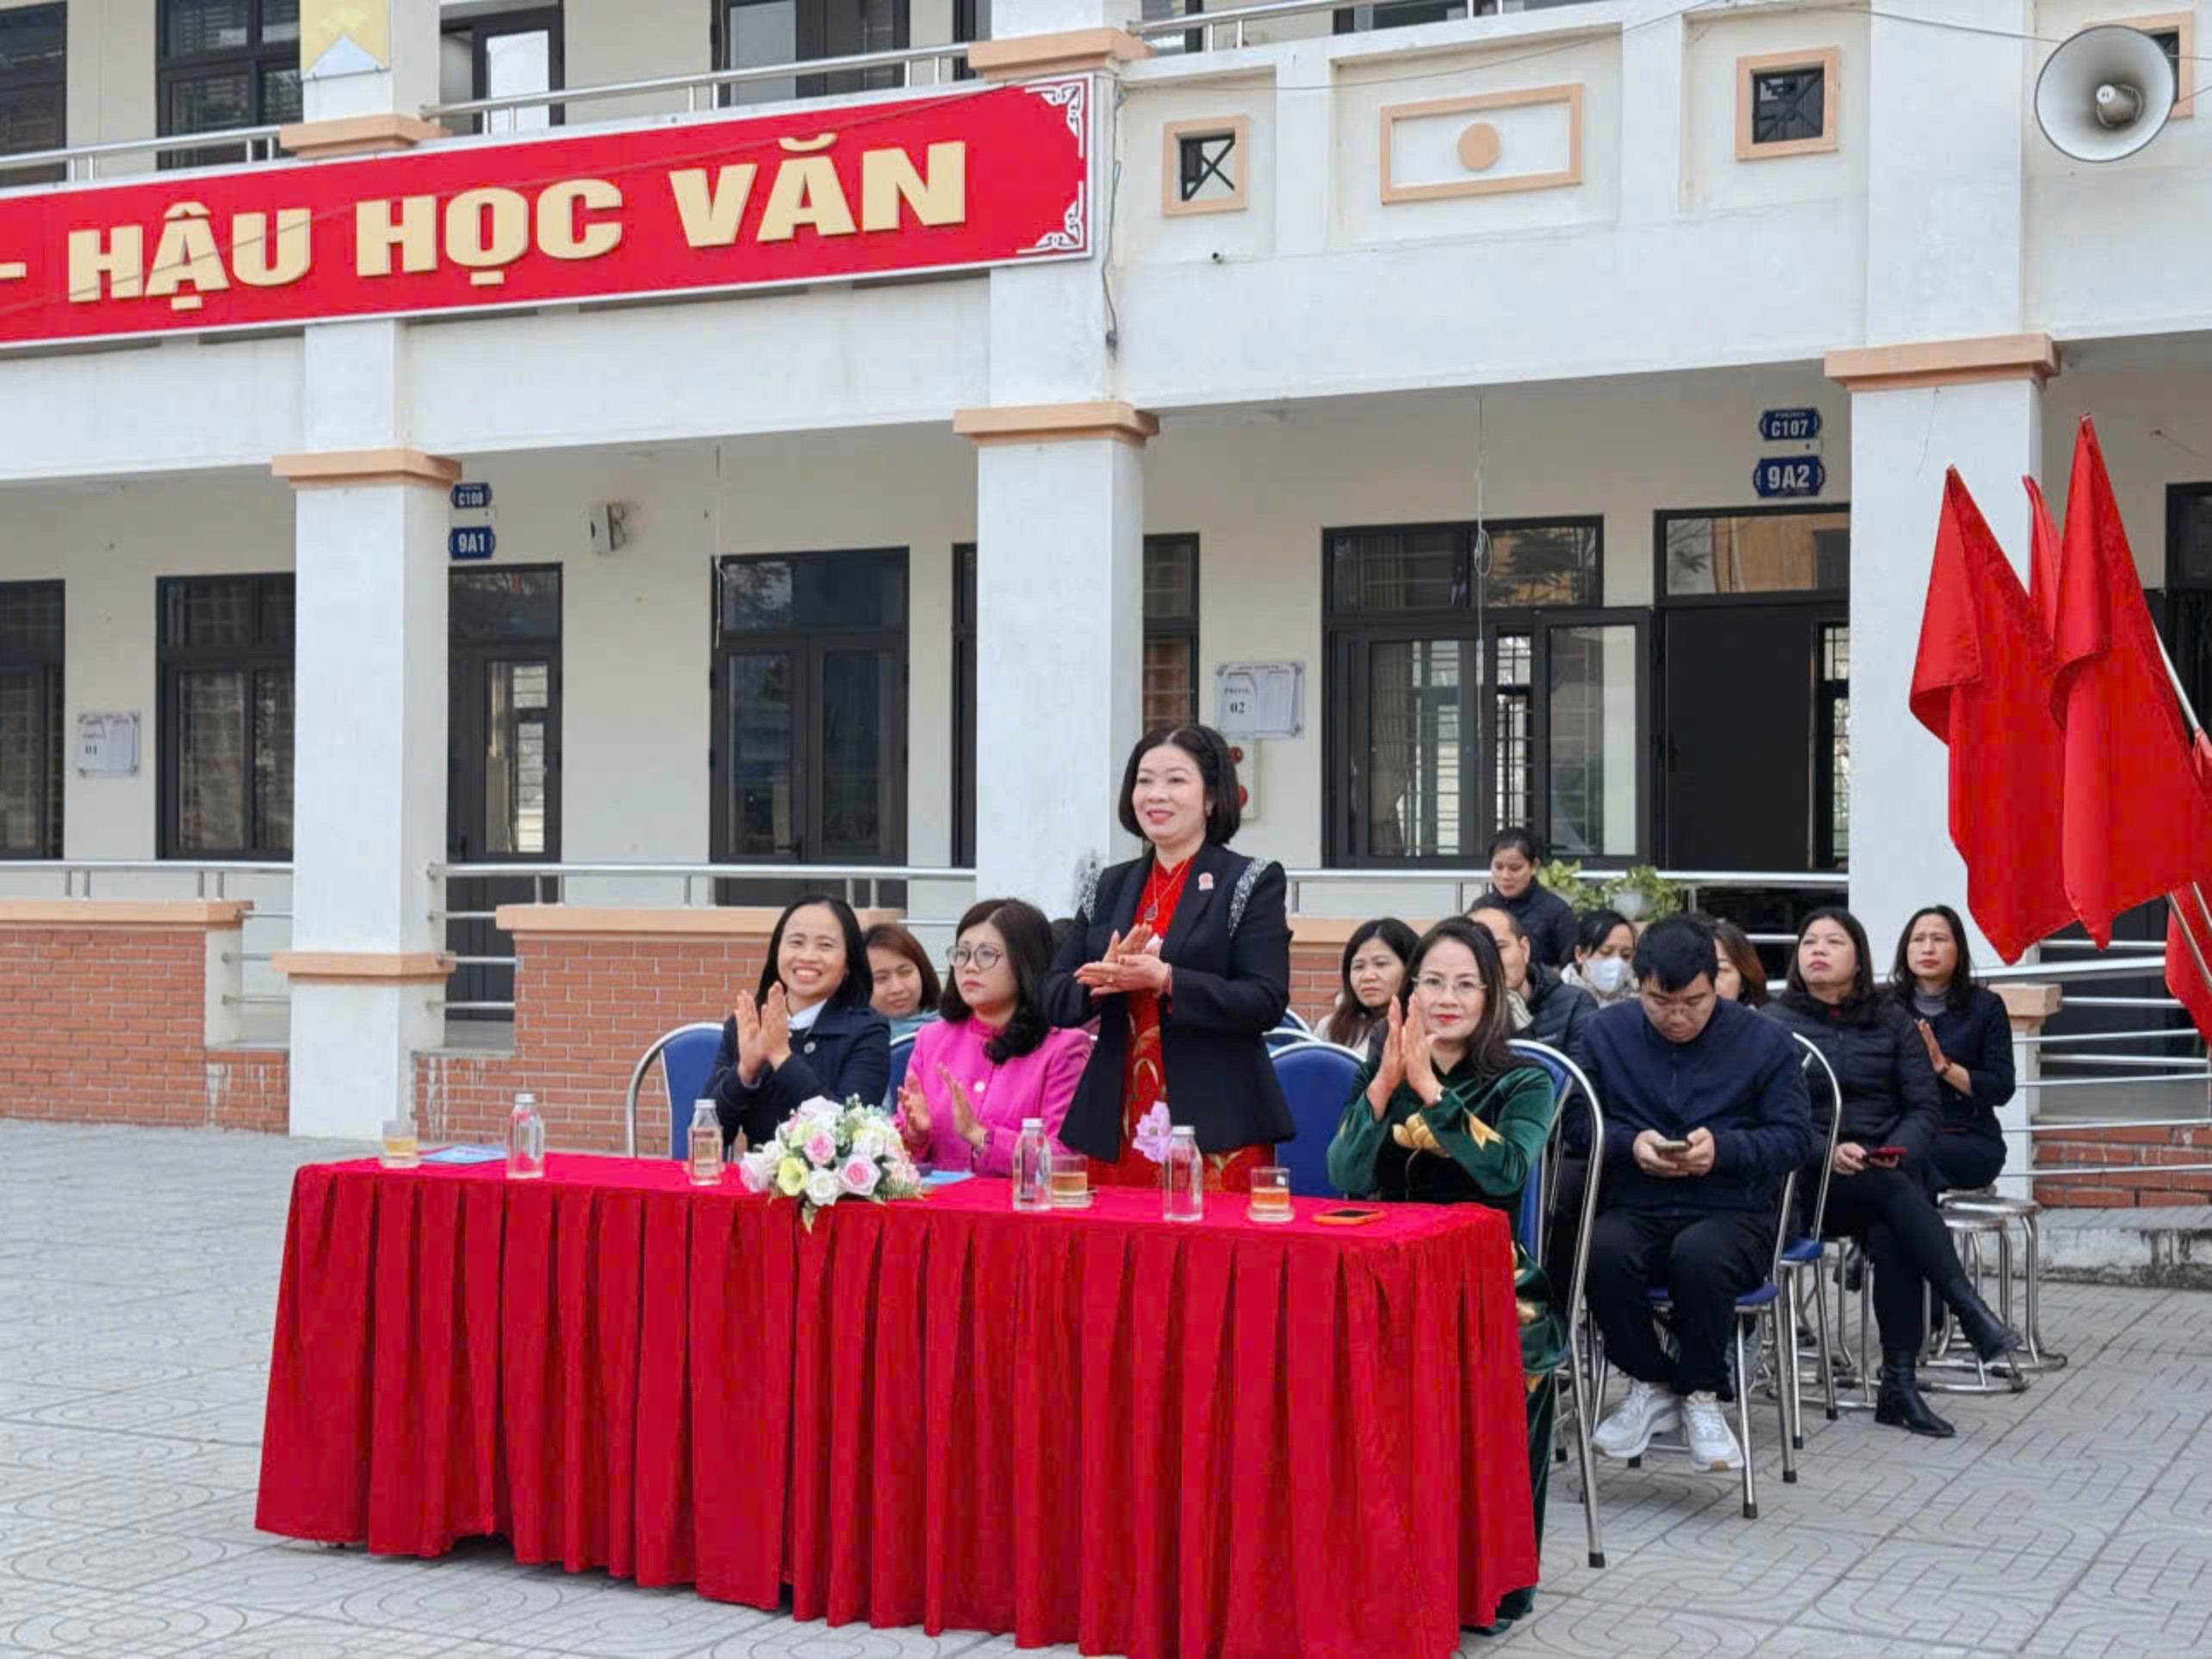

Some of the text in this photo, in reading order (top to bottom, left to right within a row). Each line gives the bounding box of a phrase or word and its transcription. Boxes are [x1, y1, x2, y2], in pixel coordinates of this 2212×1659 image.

[68, 201, 312, 311] HẬU
[356, 178, 623, 286] HỌC
[668, 132, 965, 247] VĂN
[1772, 419, 1808, 438] C107
[1768, 464, 1811, 490] 9A2
[457, 532, 485, 553] 9A1
[1229, 701, 1245, 714] 02
